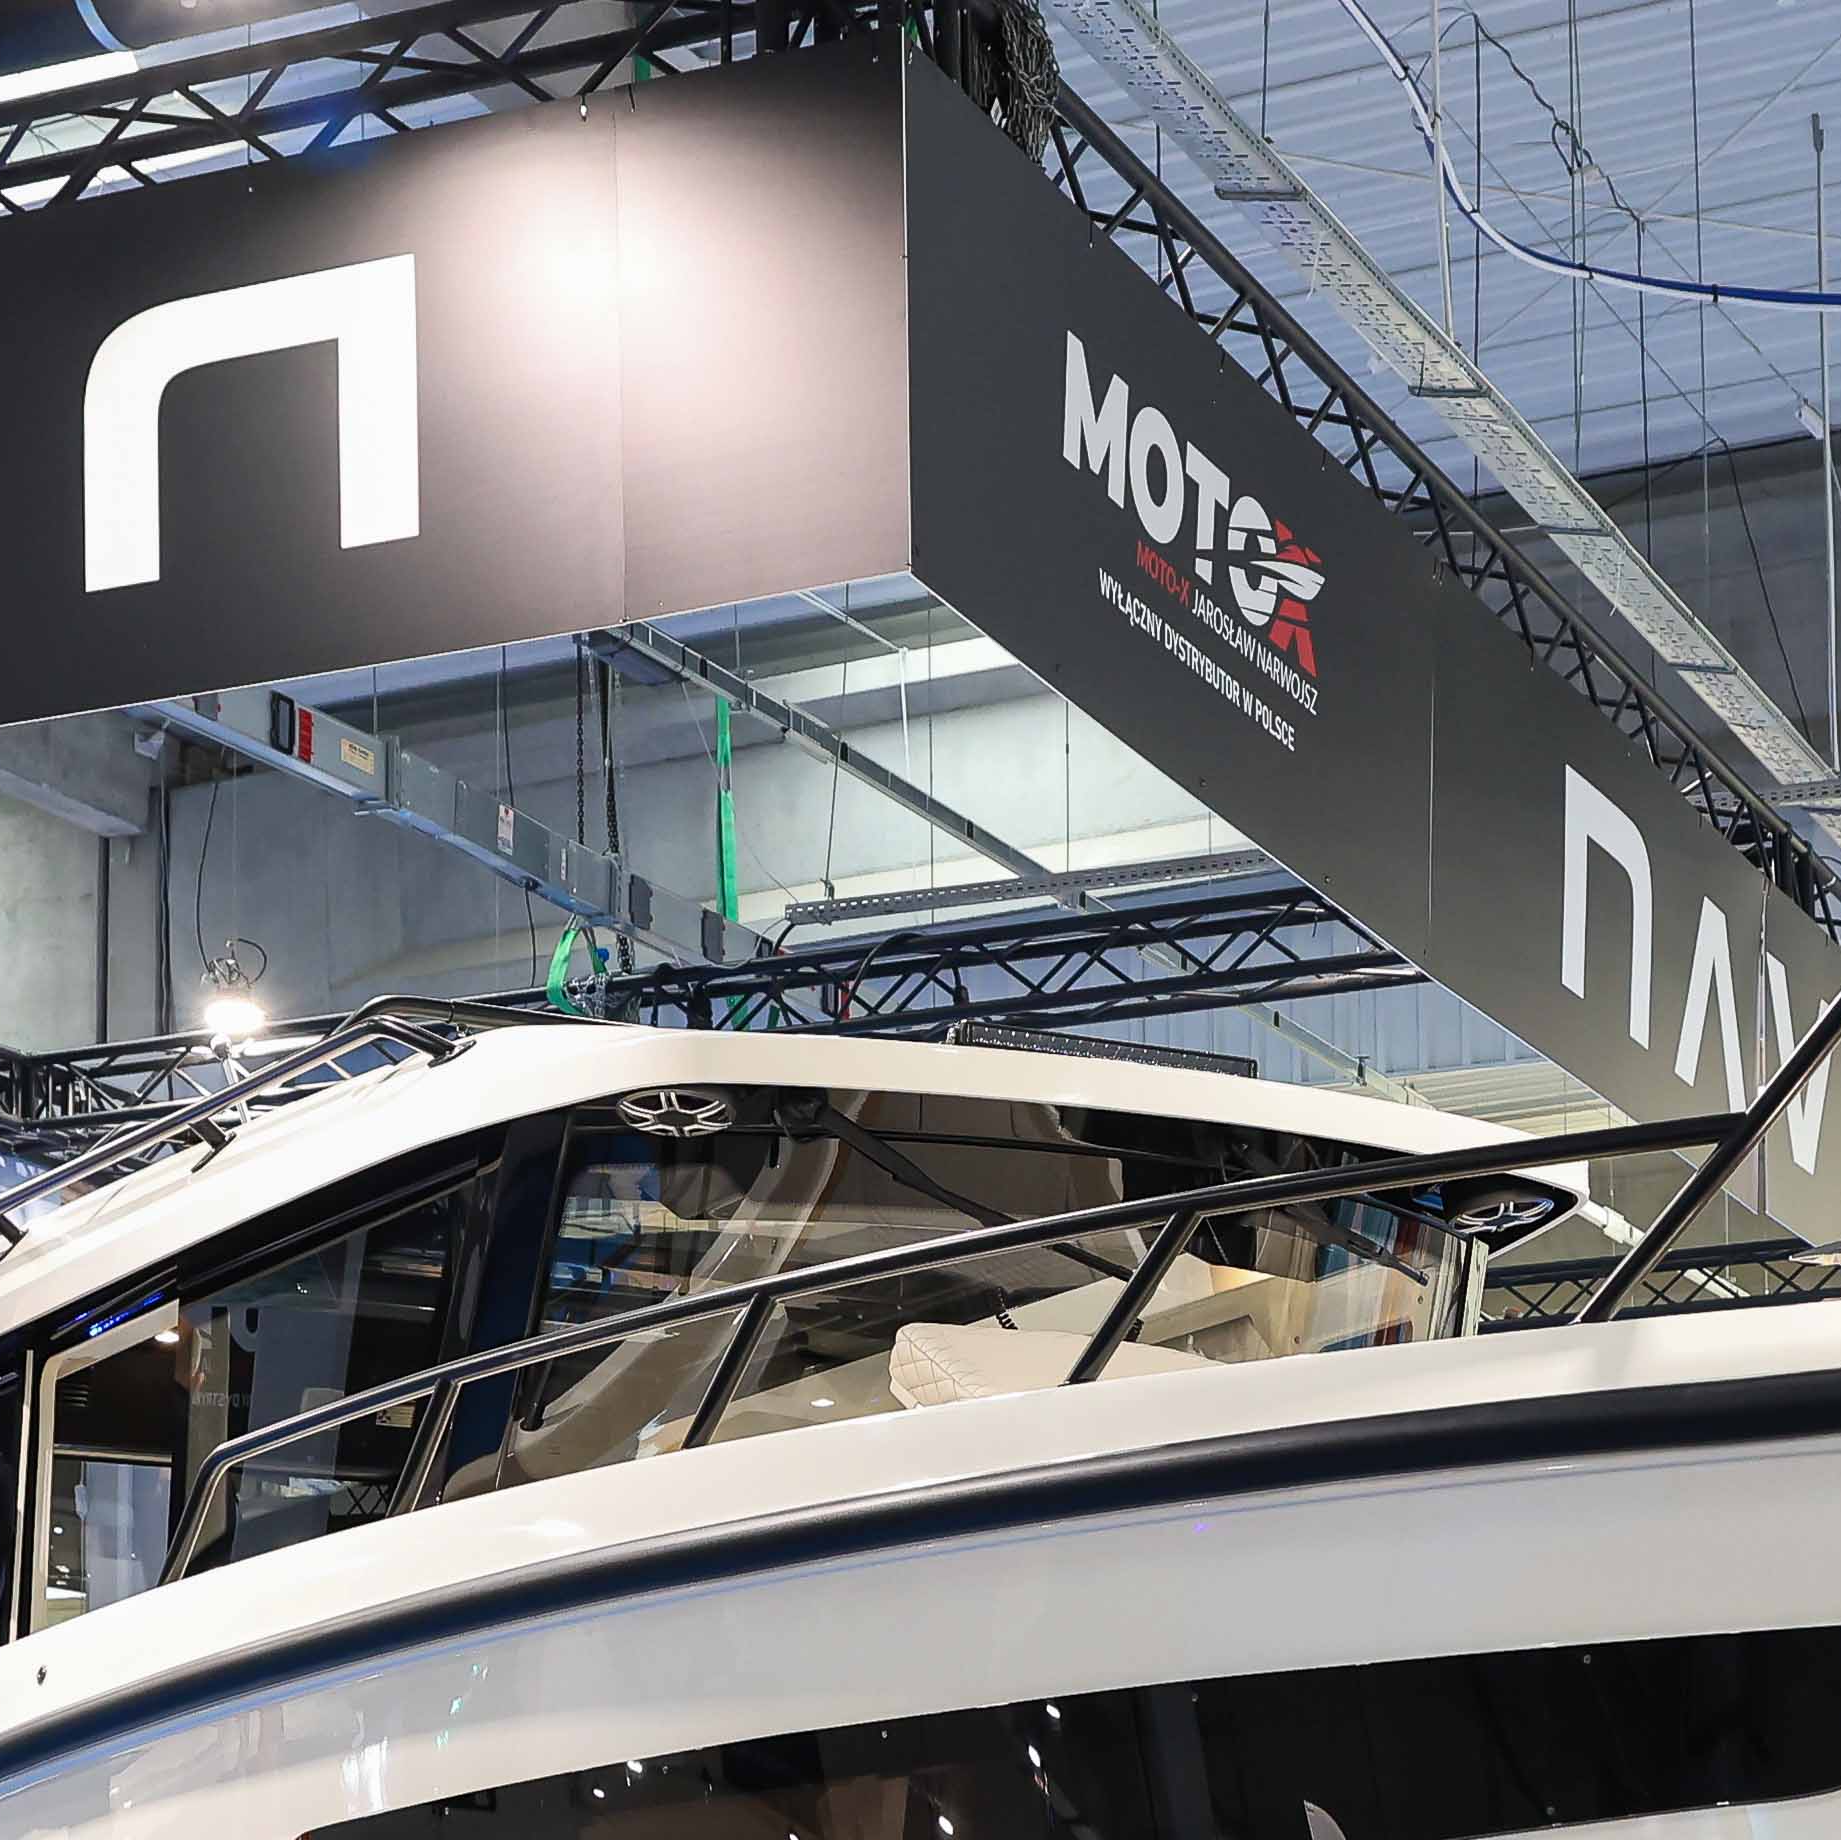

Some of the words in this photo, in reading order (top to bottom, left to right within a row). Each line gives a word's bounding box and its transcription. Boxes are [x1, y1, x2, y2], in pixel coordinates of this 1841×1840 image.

[1099, 567, 1163, 642] WYŁĄCZNY
[1164, 624, 1241, 708] DYSTRYBUTOR
[1242, 687, 1254, 717] W
[1255, 699, 1296, 752] POLSCE
[1136, 540, 1191, 608] MOTO-X
[1191, 589, 1256, 663] JAROSŁAW
[1256, 642, 1319, 716] NARWOJSZ
